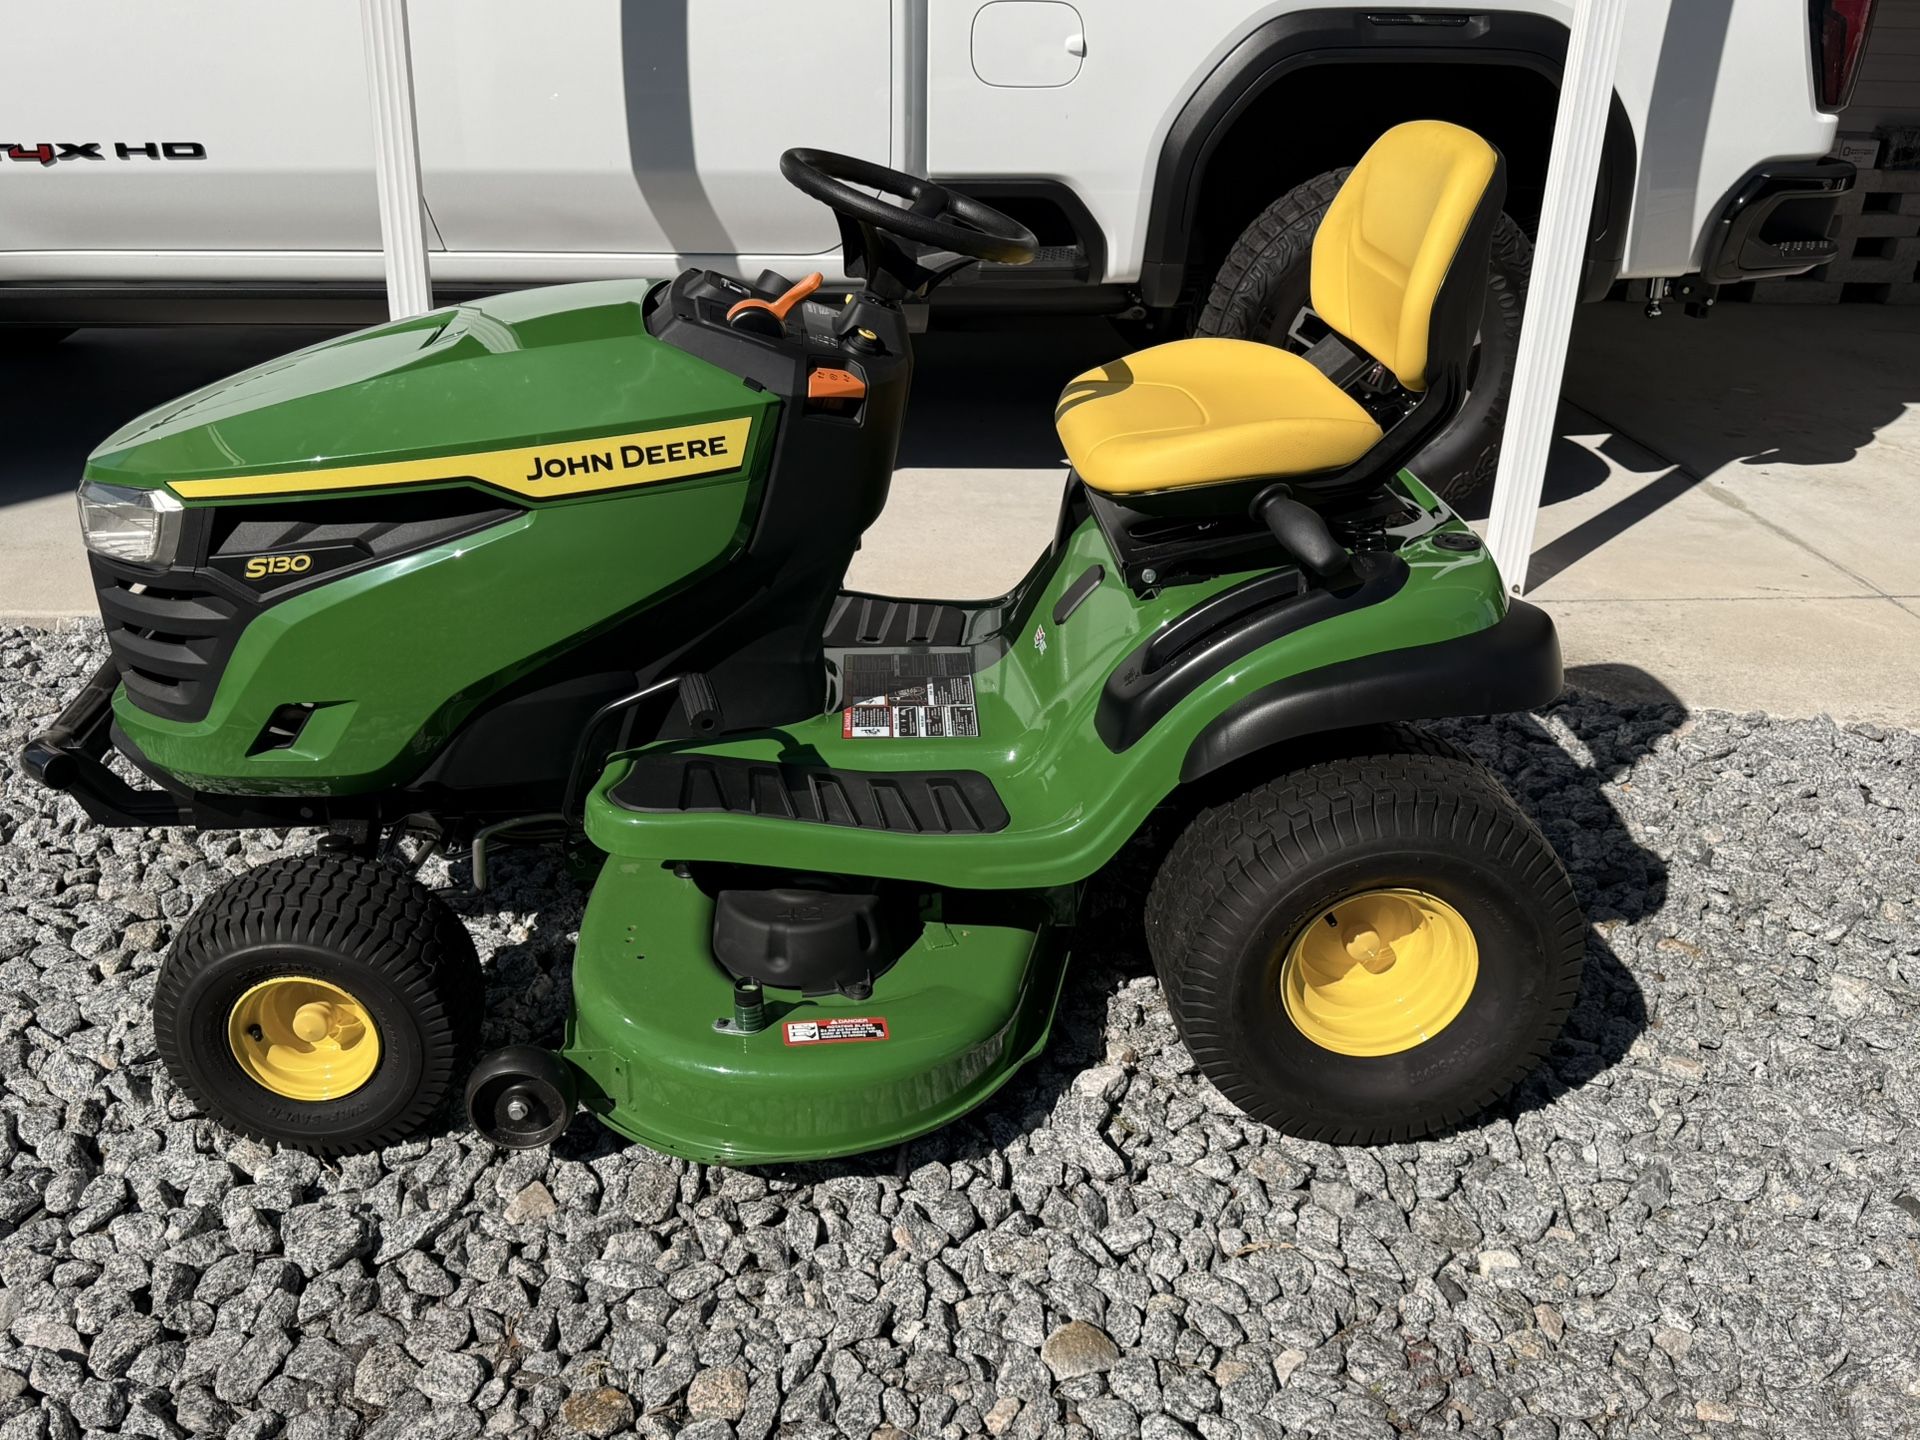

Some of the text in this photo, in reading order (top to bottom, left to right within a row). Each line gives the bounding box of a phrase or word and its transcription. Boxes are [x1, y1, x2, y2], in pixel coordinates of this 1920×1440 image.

[114, 142, 206, 160] HD
[526, 436, 727, 481] JOHN DEERE
[245, 554, 312, 578] S130
